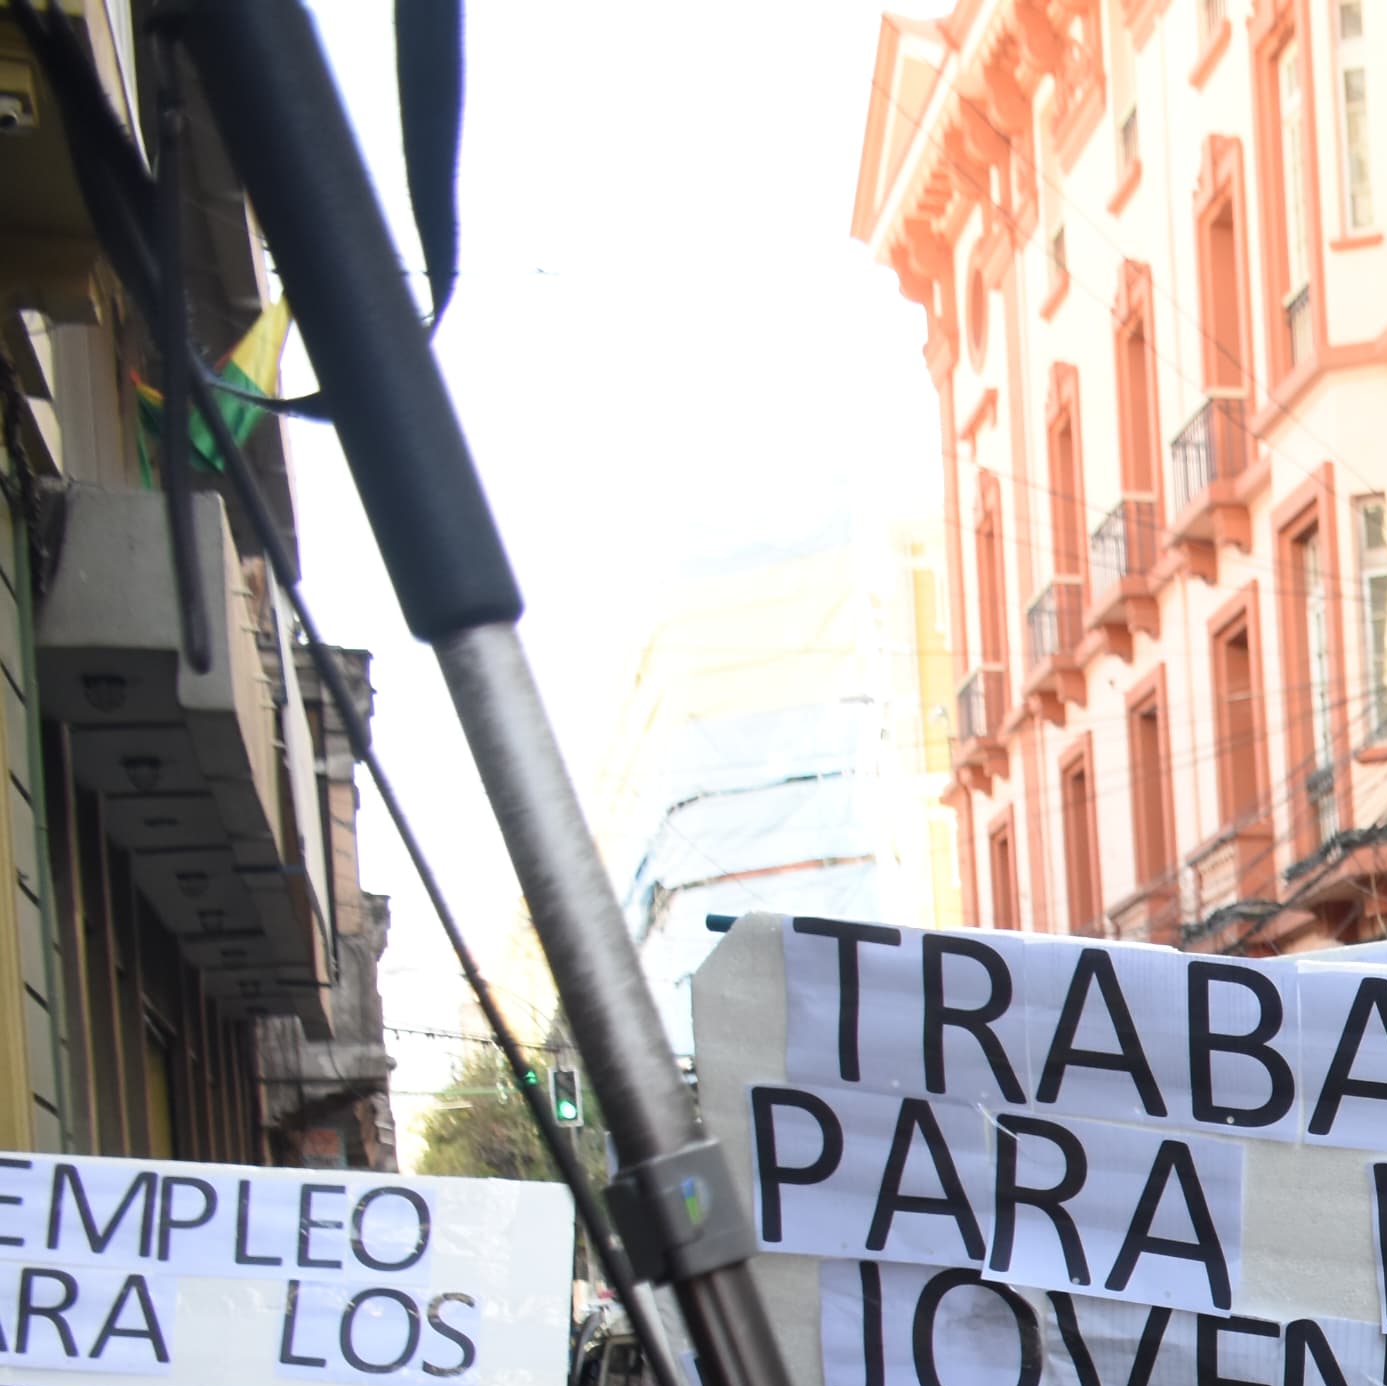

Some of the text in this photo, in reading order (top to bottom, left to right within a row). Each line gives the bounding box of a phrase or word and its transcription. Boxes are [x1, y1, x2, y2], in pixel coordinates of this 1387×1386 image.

[752, 1086, 1232, 1311] PARA
[0, 1268, 477, 1377] RA LOS
